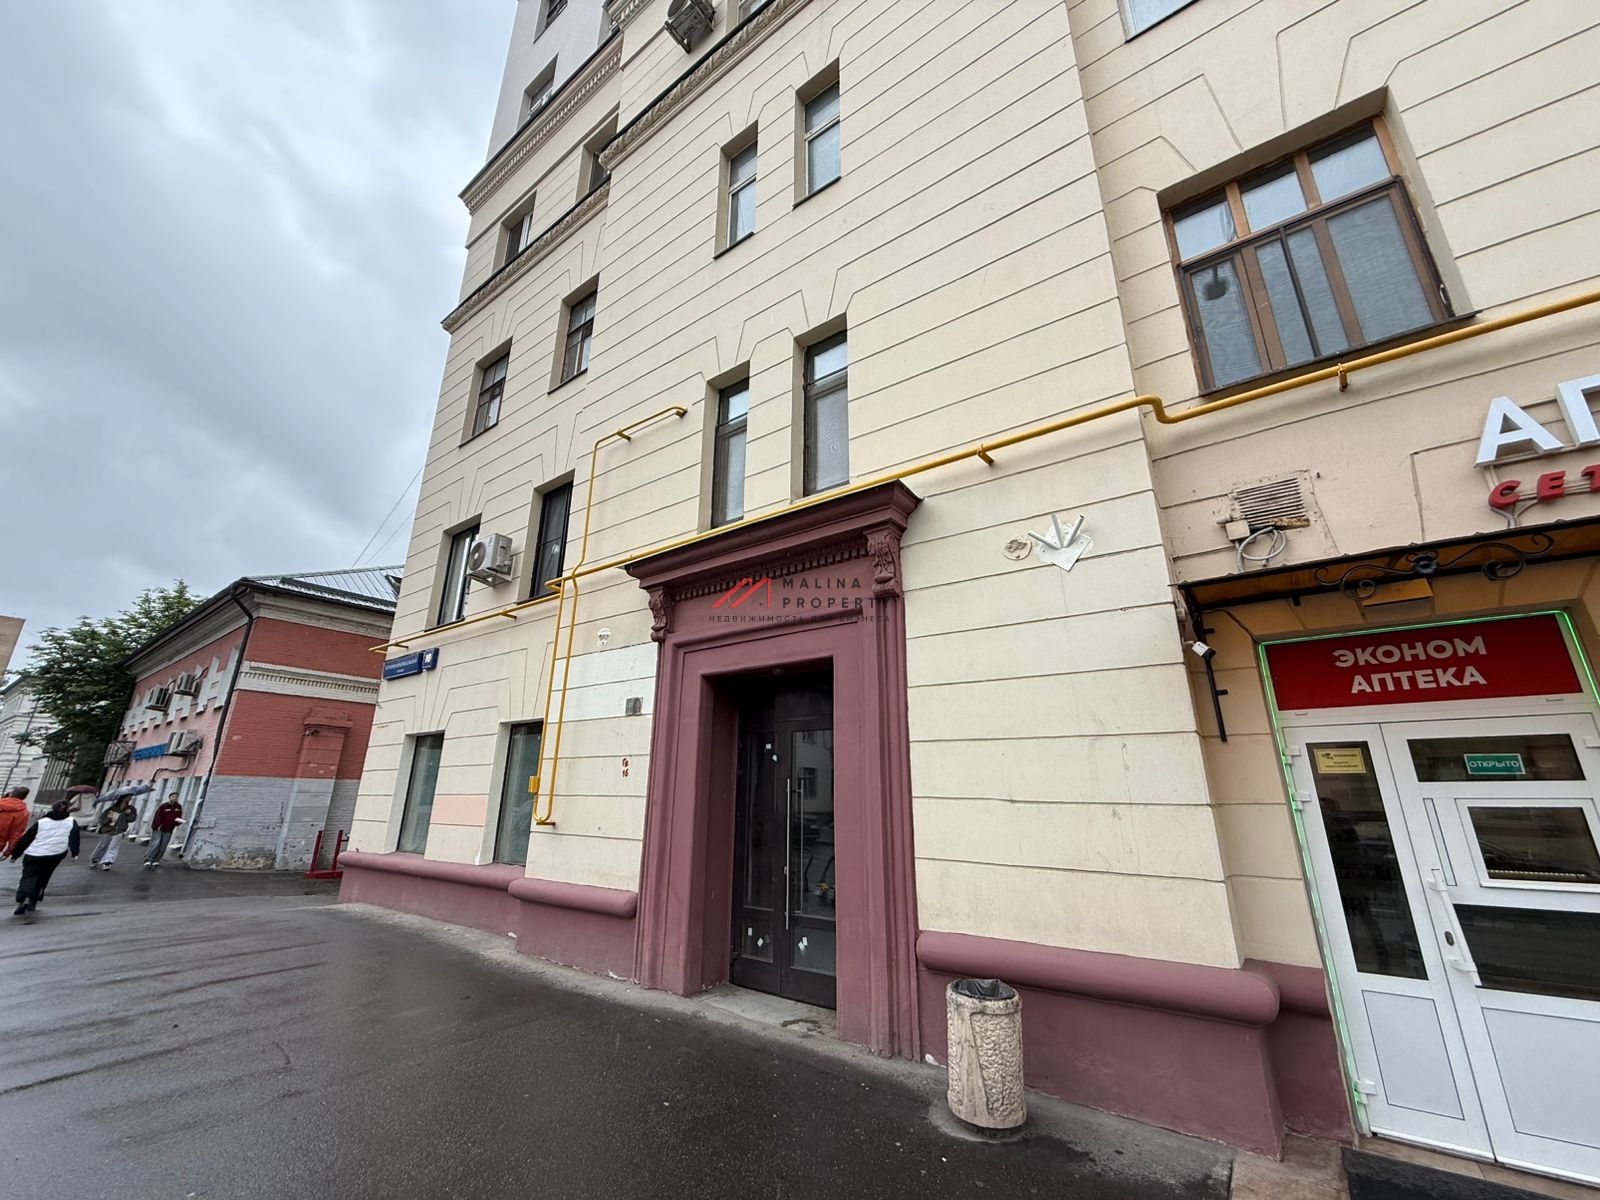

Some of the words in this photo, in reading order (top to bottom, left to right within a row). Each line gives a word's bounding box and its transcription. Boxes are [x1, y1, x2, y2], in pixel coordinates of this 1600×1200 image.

[1333, 636, 1487, 667] ЭКОНОМ
[1351, 666, 1488, 693] АПТЕКА
[1469, 760, 1520, 768] ОТКРЫТО
